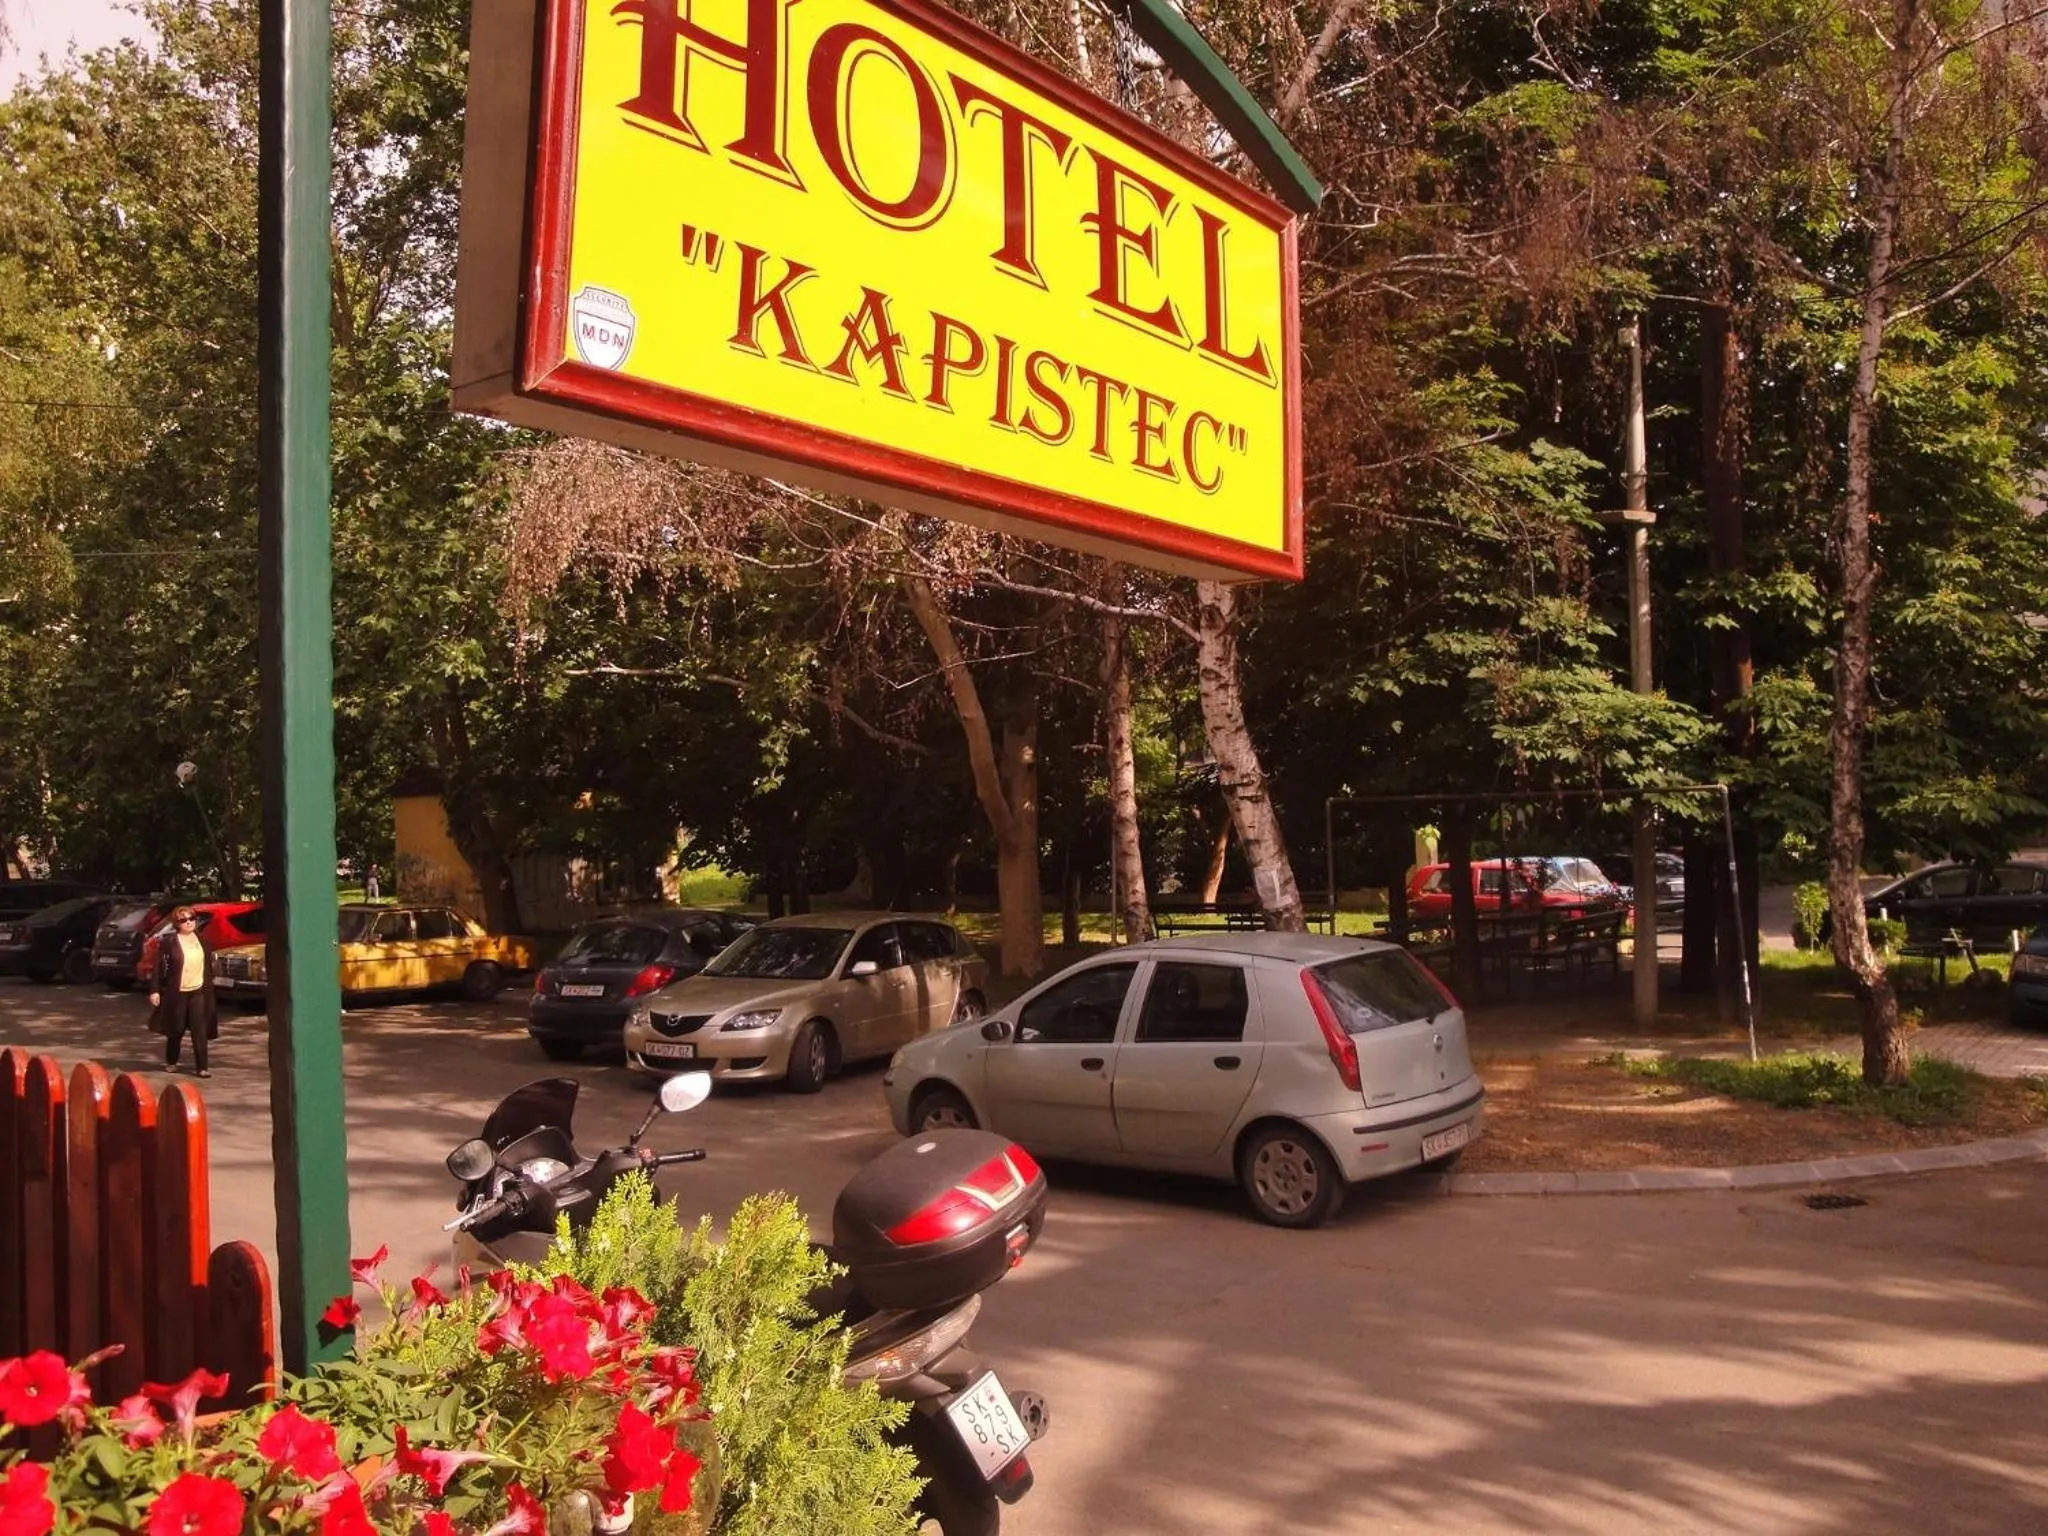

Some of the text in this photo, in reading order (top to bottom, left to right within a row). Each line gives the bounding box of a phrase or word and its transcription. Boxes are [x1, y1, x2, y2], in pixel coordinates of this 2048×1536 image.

[609, 0, 1279, 389] HOTEL
[581, 322, 625, 349] MDN
[681, 223, 1249, 495] "KAPISTEC"
[962, 1393, 988, 1424] SK
[973, 1404, 1009, 1444] 879
[996, 1424, 1020, 1454] SK
